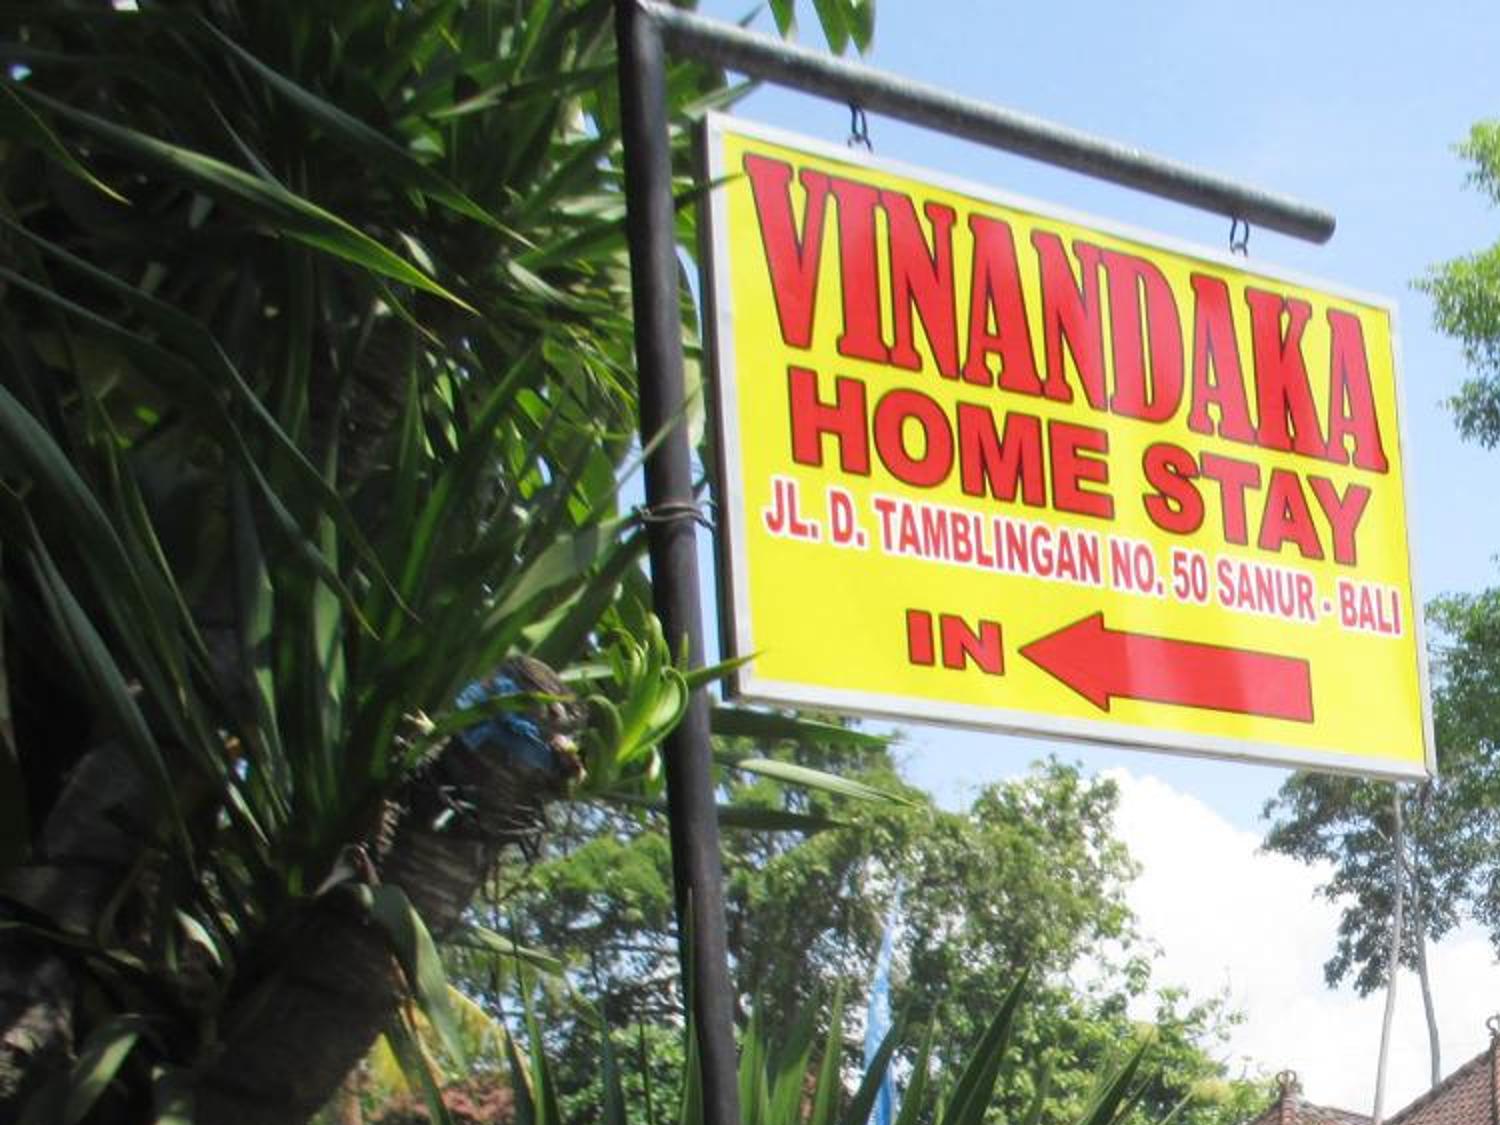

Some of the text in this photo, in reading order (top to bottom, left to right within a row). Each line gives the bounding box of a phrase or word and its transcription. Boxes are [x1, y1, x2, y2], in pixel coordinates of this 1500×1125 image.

[743, 152, 1389, 474] VINANDAKA
[787, 365, 1372, 566] HOME STAY
[765, 480, 820, 540] JL.
[832, 499, 866, 548] D.
[875, 499, 1100, 585] TAMBLINGAN
[1112, 553, 1164, 595] NO.
[1173, 551, 1208, 603] 50
[1218, 564, 1314, 621] SANUR
[1340, 586, 1402, 636] BALI
[906, 608, 1005, 676] IN
